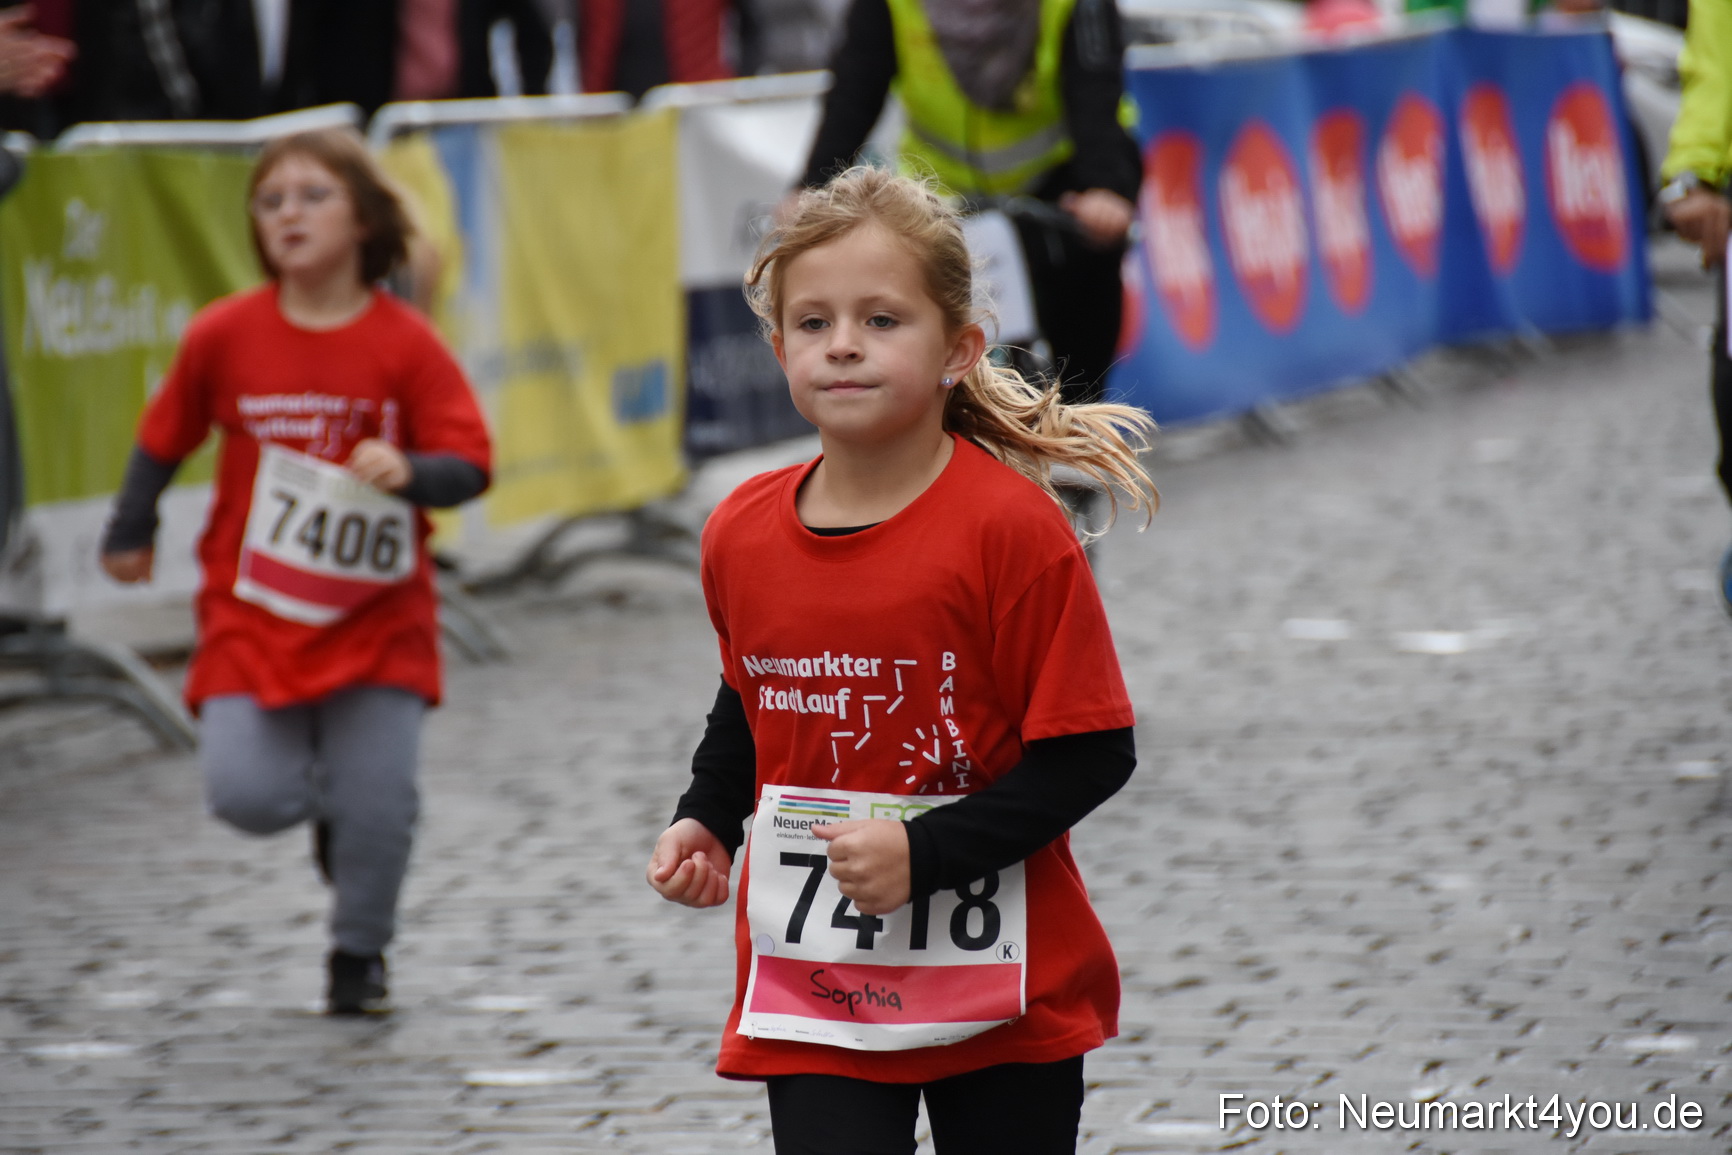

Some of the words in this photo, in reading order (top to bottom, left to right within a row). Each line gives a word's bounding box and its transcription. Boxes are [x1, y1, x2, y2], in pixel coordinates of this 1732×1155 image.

[270, 489, 400, 574] 7406
[742, 651, 882, 678] Neumarkter
[758, 685, 851, 720] StadLauf
[939, 651, 971, 789] BAMBINI
[773, 815, 840, 831] NeuerM
[776, 832, 804, 840] einkaufen
[779, 851, 1001, 951] 7418
[810, 968, 903, 1017] Sophia
